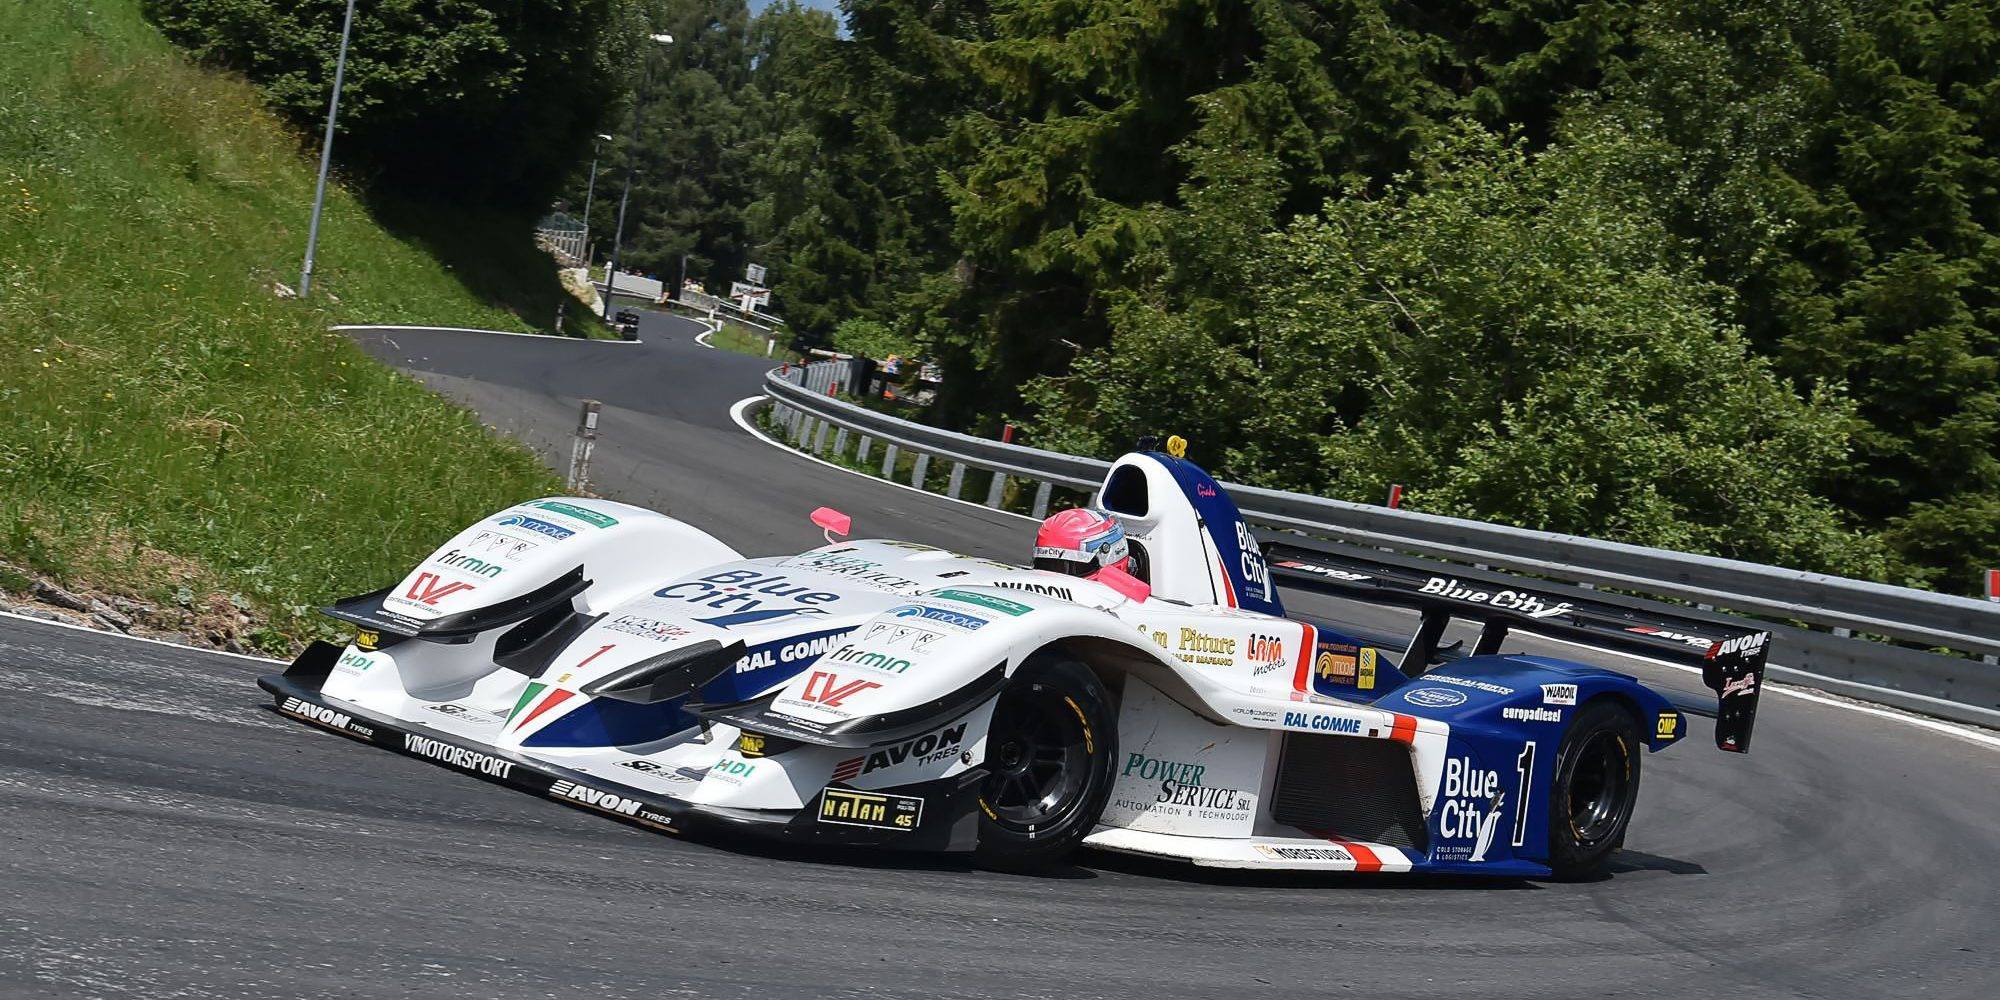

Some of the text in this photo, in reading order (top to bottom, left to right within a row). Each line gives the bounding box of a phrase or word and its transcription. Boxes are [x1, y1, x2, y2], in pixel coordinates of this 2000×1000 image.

[526, 521, 570, 540] moove
[437, 549, 503, 578] firmin
[1241, 551, 1269, 594] City
[698, 570, 841, 606] Blue
[1419, 577, 1568, 618] Blue City
[653, 582, 795, 626] City
[927, 611, 984, 630] moove
[1179, 627, 1236, 655] Pitture
[1717, 632, 1768, 657] AVON
[340, 654, 374, 670] HDI
[577, 644, 616, 668] 1
[736, 651, 776, 674] RAL
[829, 644, 912, 673] firmin
[1253, 659, 1287, 677] motors
[296, 701, 373, 737] AVON TYRES
[1284, 712, 1309, 728] RAL
[1312, 715, 1361, 733] GOMME
[1502, 707, 1561, 722] europadiesel
[1657, 718, 1677, 734] OMP
[405, 734, 517, 779] VIMOTORSPORT
[861, 722, 968, 775] AVON
[918, 745, 960, 767] TYRES
[715, 758, 756, 778] HDI
[1121, 752, 1205, 785] POWER
[1445, 756, 1498, 799] Blue
[570, 785, 671, 825] AVON TYRES
[1157, 779, 1237, 810] SERVICE
[1512, 741, 1537, 847] 1
[1115, 799, 1181, 816] AUTOMATION
[1199, 810, 1249, 822] TECHNOLOGY
[1440, 799, 1491, 850] City
